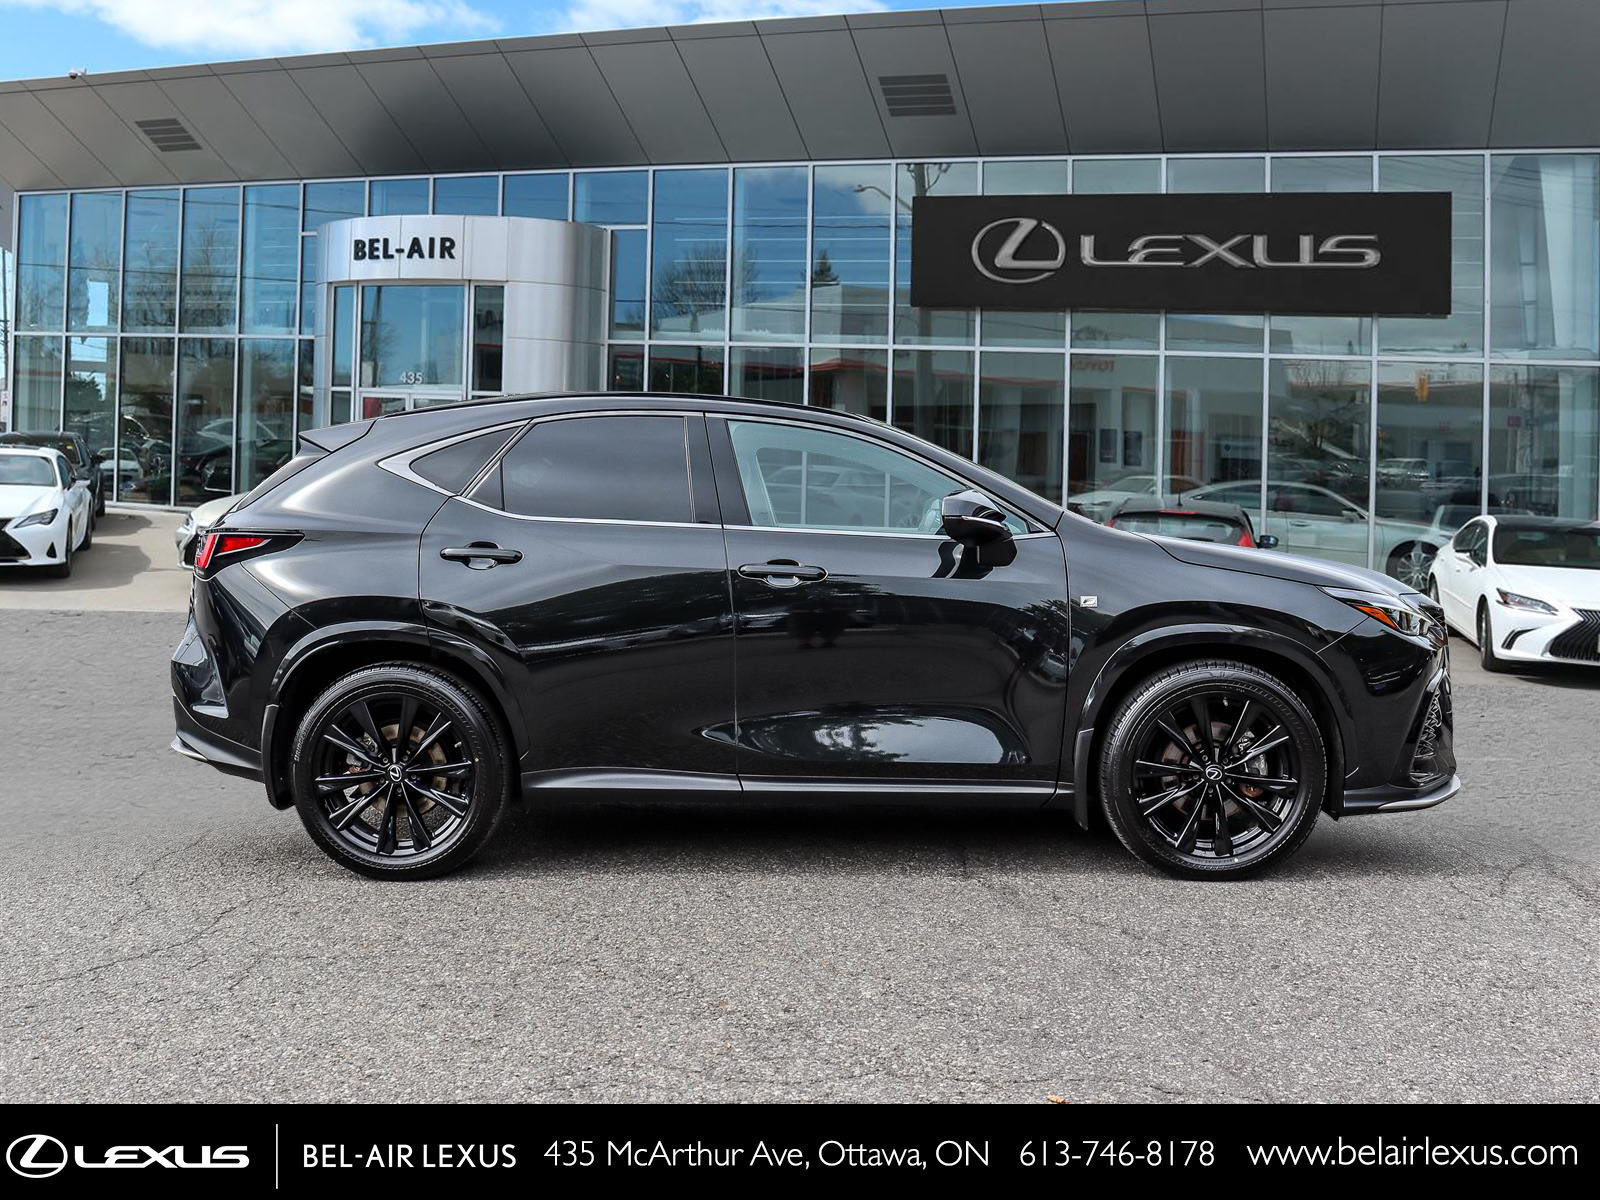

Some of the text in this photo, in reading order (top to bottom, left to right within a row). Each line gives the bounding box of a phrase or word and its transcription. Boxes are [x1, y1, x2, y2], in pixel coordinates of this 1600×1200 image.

[353, 237, 456, 261] BEL-AIR
[1080, 234, 1382, 268] LEXUS
[400, 372, 423, 384] 435
